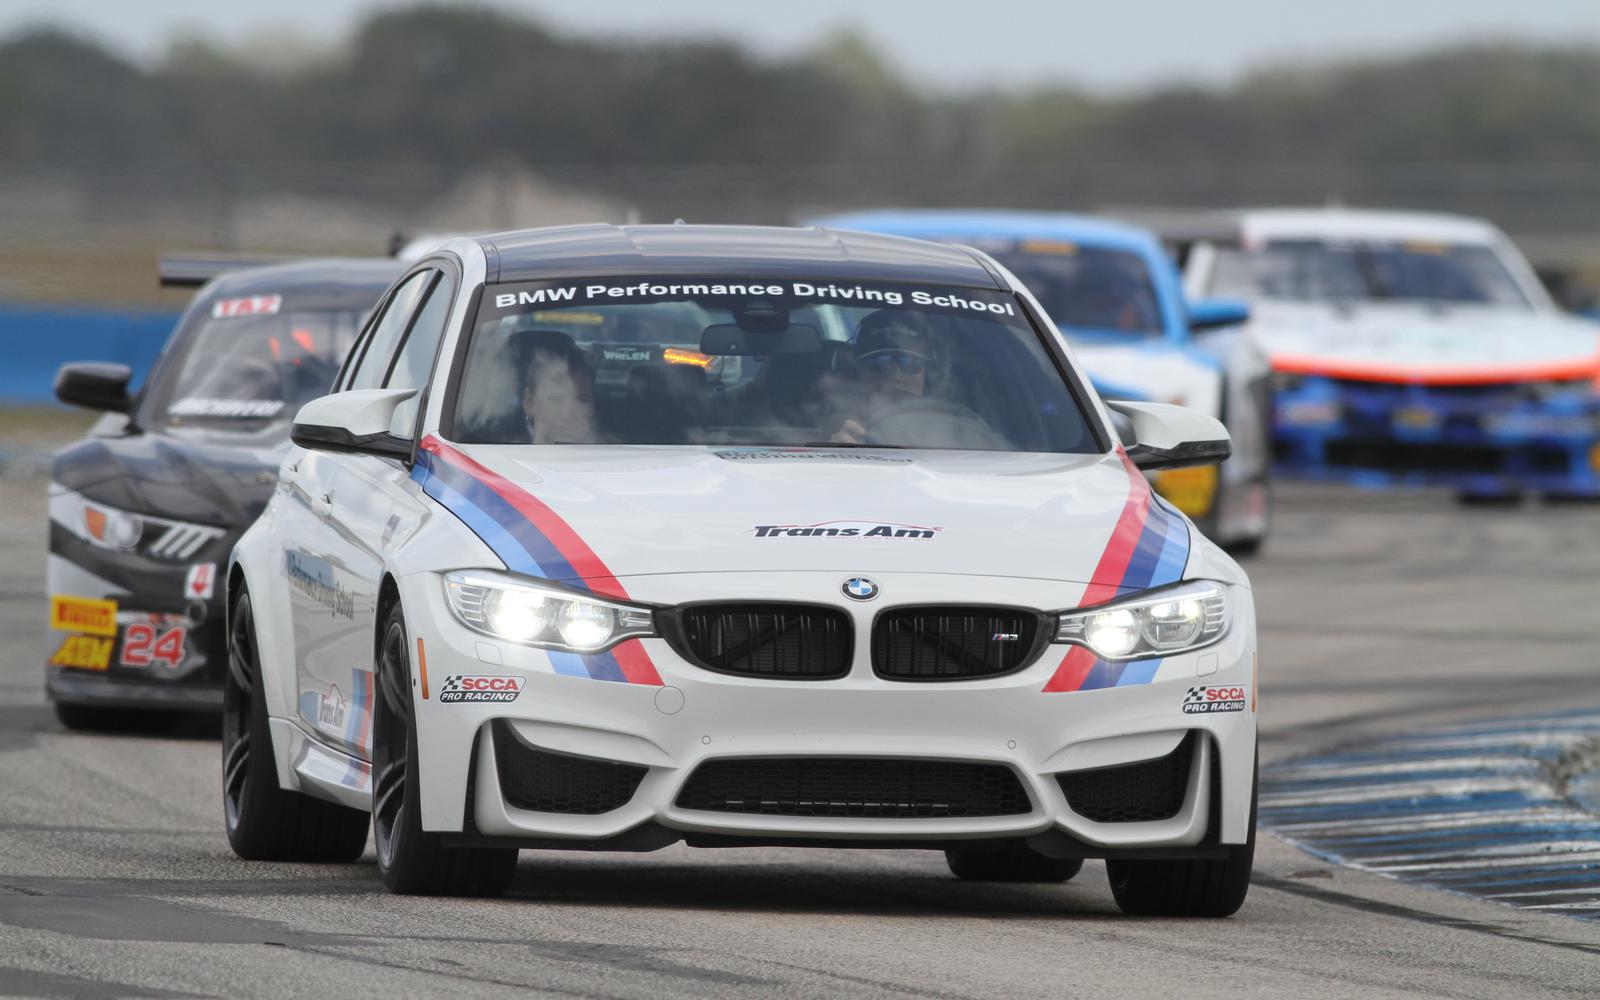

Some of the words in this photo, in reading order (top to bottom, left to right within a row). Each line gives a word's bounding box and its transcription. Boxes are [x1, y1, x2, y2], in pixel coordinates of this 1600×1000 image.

[496, 287, 577, 308] BMW
[586, 282, 784, 299] Performance
[793, 283, 903, 305] Driving
[911, 291, 1015, 316] School
[754, 525, 860, 538] Trans
[863, 525, 935, 539] Am
[120, 623, 186, 669] 24
[461, 678, 519, 691] SCCA
[441, 692, 462, 701] PRO
[464, 692, 516, 701] RACING
[1205, 687, 1245, 701] SCCA
[1184, 703, 1209, 713] PRO
[1210, 701, 1244, 712] RACING
